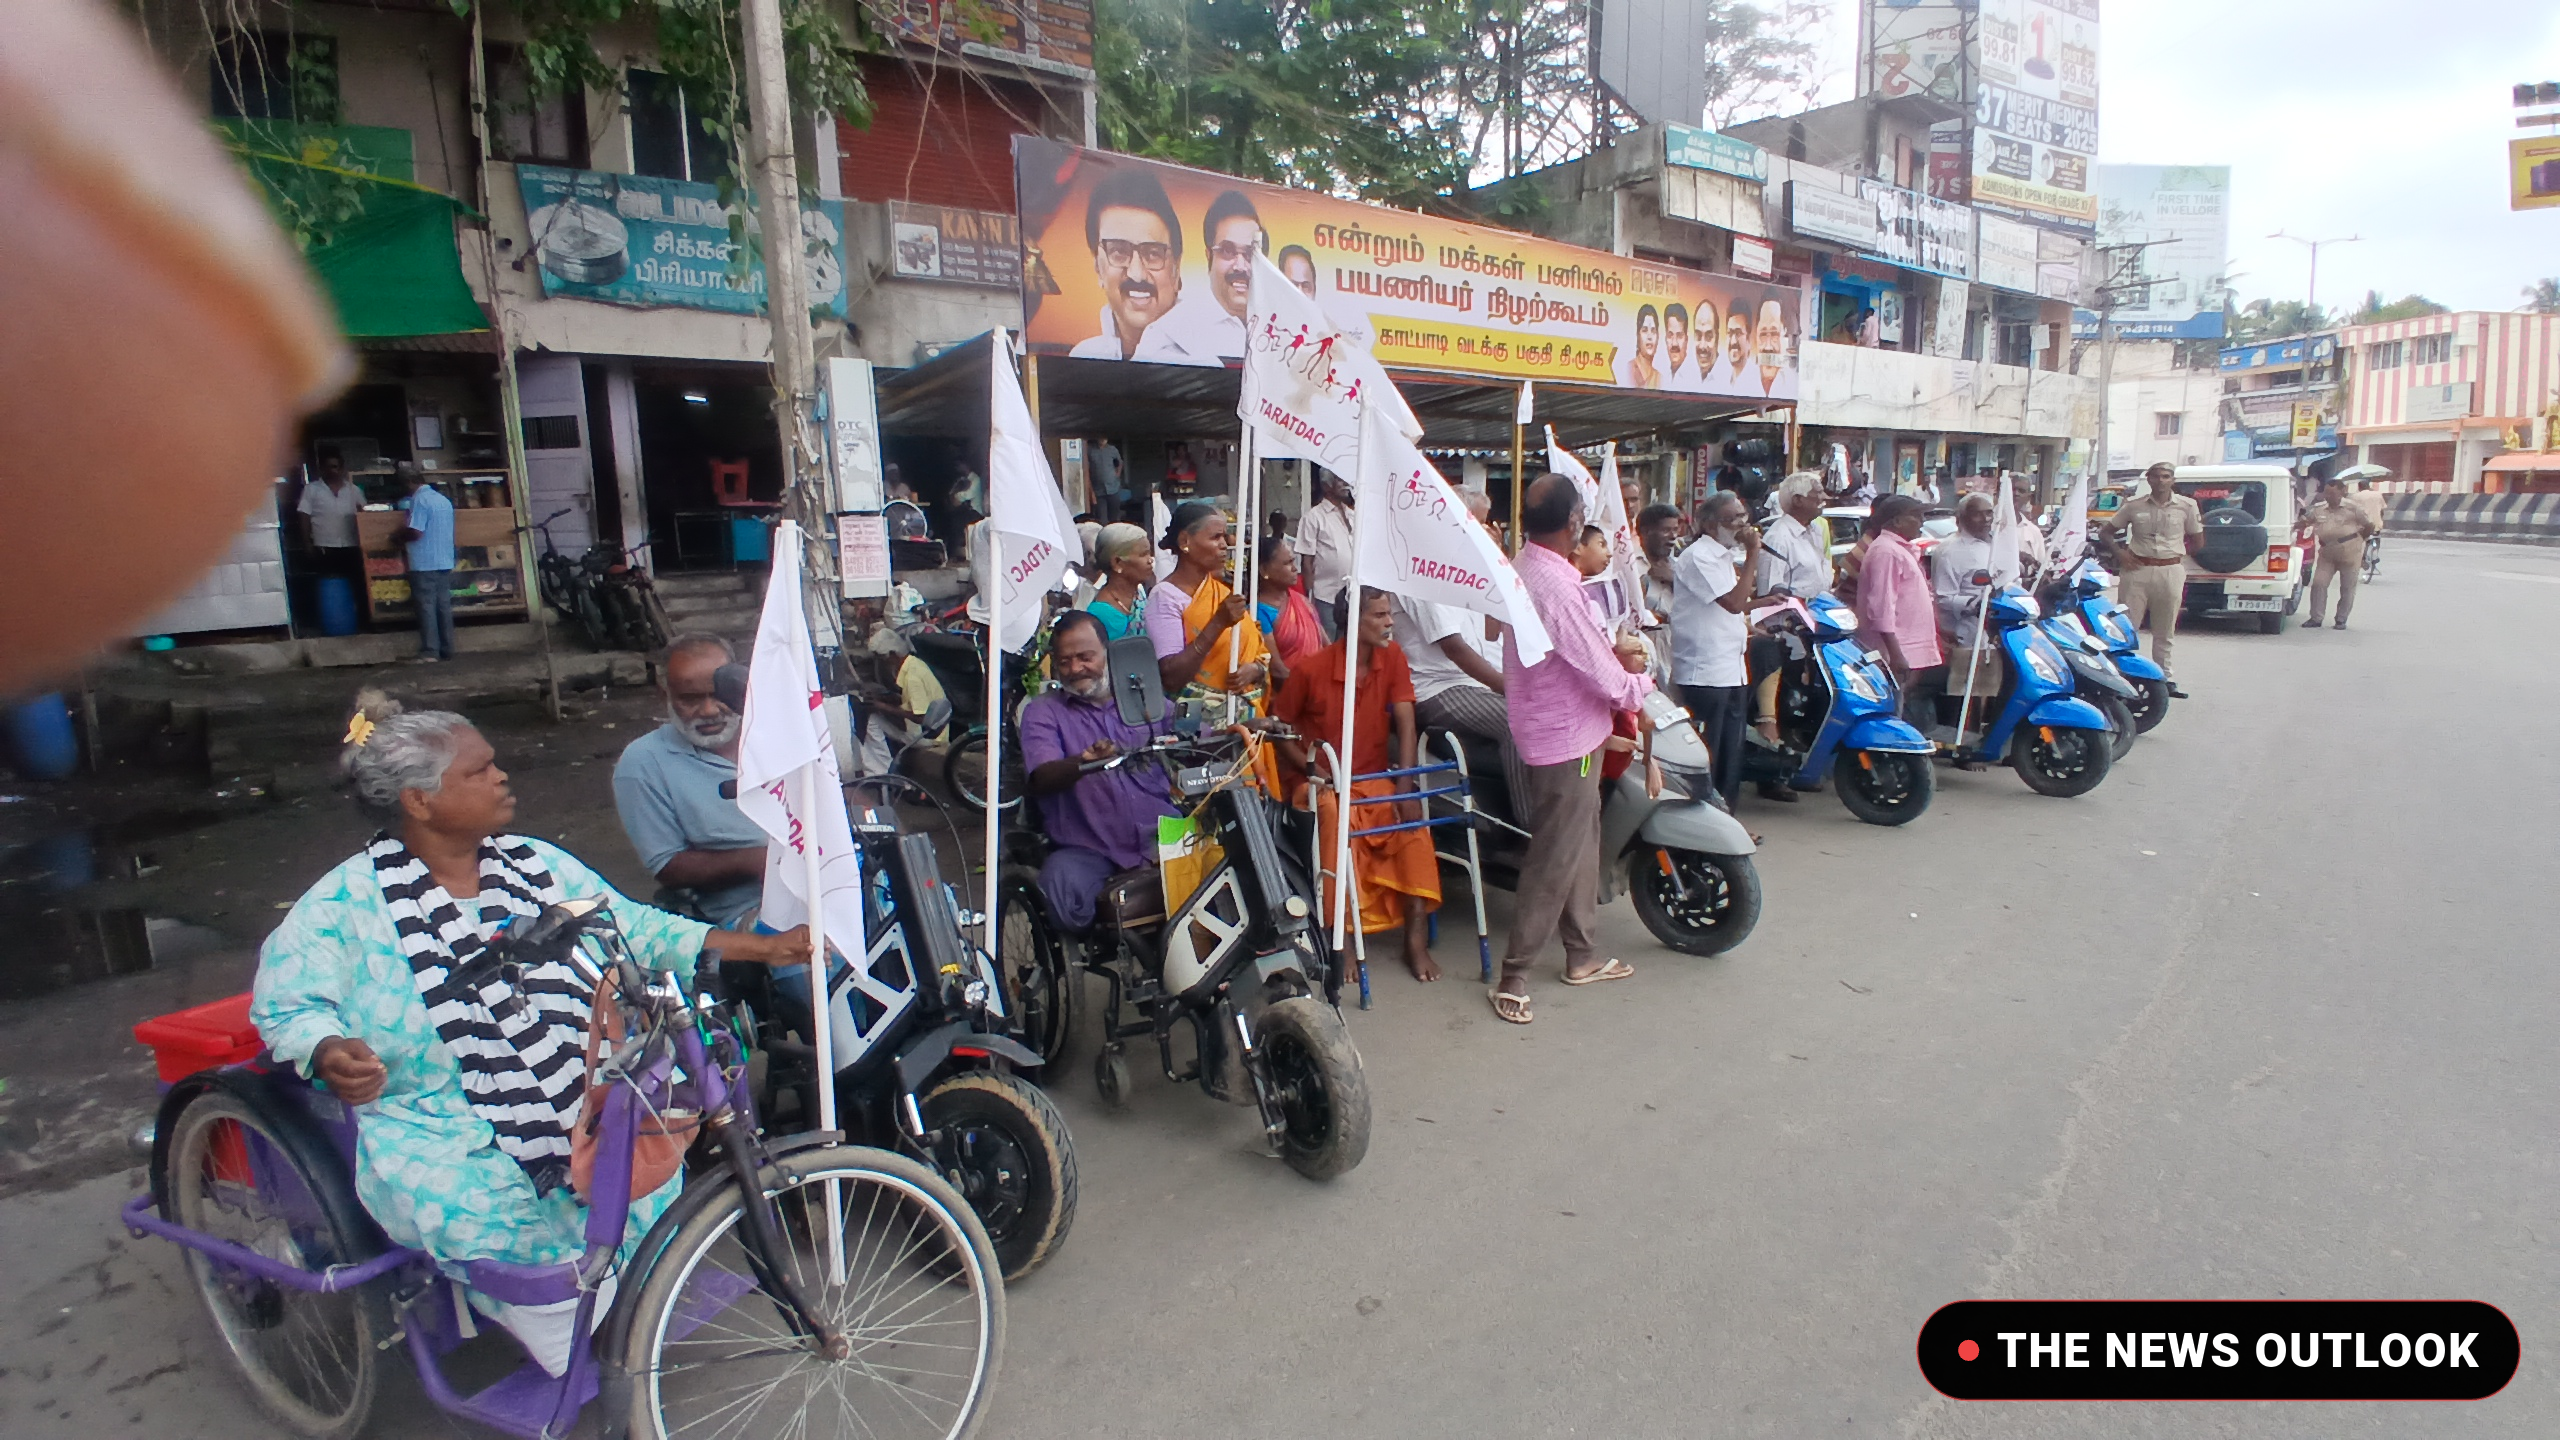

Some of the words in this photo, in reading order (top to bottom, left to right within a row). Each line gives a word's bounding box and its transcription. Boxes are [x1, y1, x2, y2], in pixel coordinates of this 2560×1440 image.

[1983, 35, 2016, 65] 99.81
[2062, 61, 2095, 88] 99.62
[1976, 82, 2006, 127] 37
[2007, 90, 2044, 120] MERIT
[2046, 102, 2097, 133] MEDICAL
[2006, 112, 2052, 142] SEATS
[2063, 127, 2098, 153] 2025
[2011, 143, 2019, 160] 2
[1982, 179, 2023, 199] ADMISSIONS
[2024, 188, 2042, 203] OPEN
[2043, 191, 2058, 205] FOR
[2058, 194, 2080, 210] GRADE
[2156, 205, 2170, 215] IN
[2171, 205, 2222, 216] VELLORE
[2157, 194, 2190, 205] FIRST
[2193, 194, 2222, 205] TIME
[1314, 222, 1424, 267] என்றும்
[1439, 244, 1525, 280] மக்கள்
[1538, 264, 1622, 296] பனியில்
[1923, 240, 1967, 268] STUDIO
[1336, 268, 1473, 312] பயணியர்
[1487, 287, 1610, 327] நிழற்கூடம்
[1379, 327, 1448, 356] காட்பாடி
[1457, 335, 1508, 362] வடக்கு
[1516, 342, 1552, 366] பகுதி
[1560, 344, 1604, 370] தி.மு.க
[1258, 397, 1326, 447] TARATDAC
[1411, 556, 1489, 591] TARATDAC
